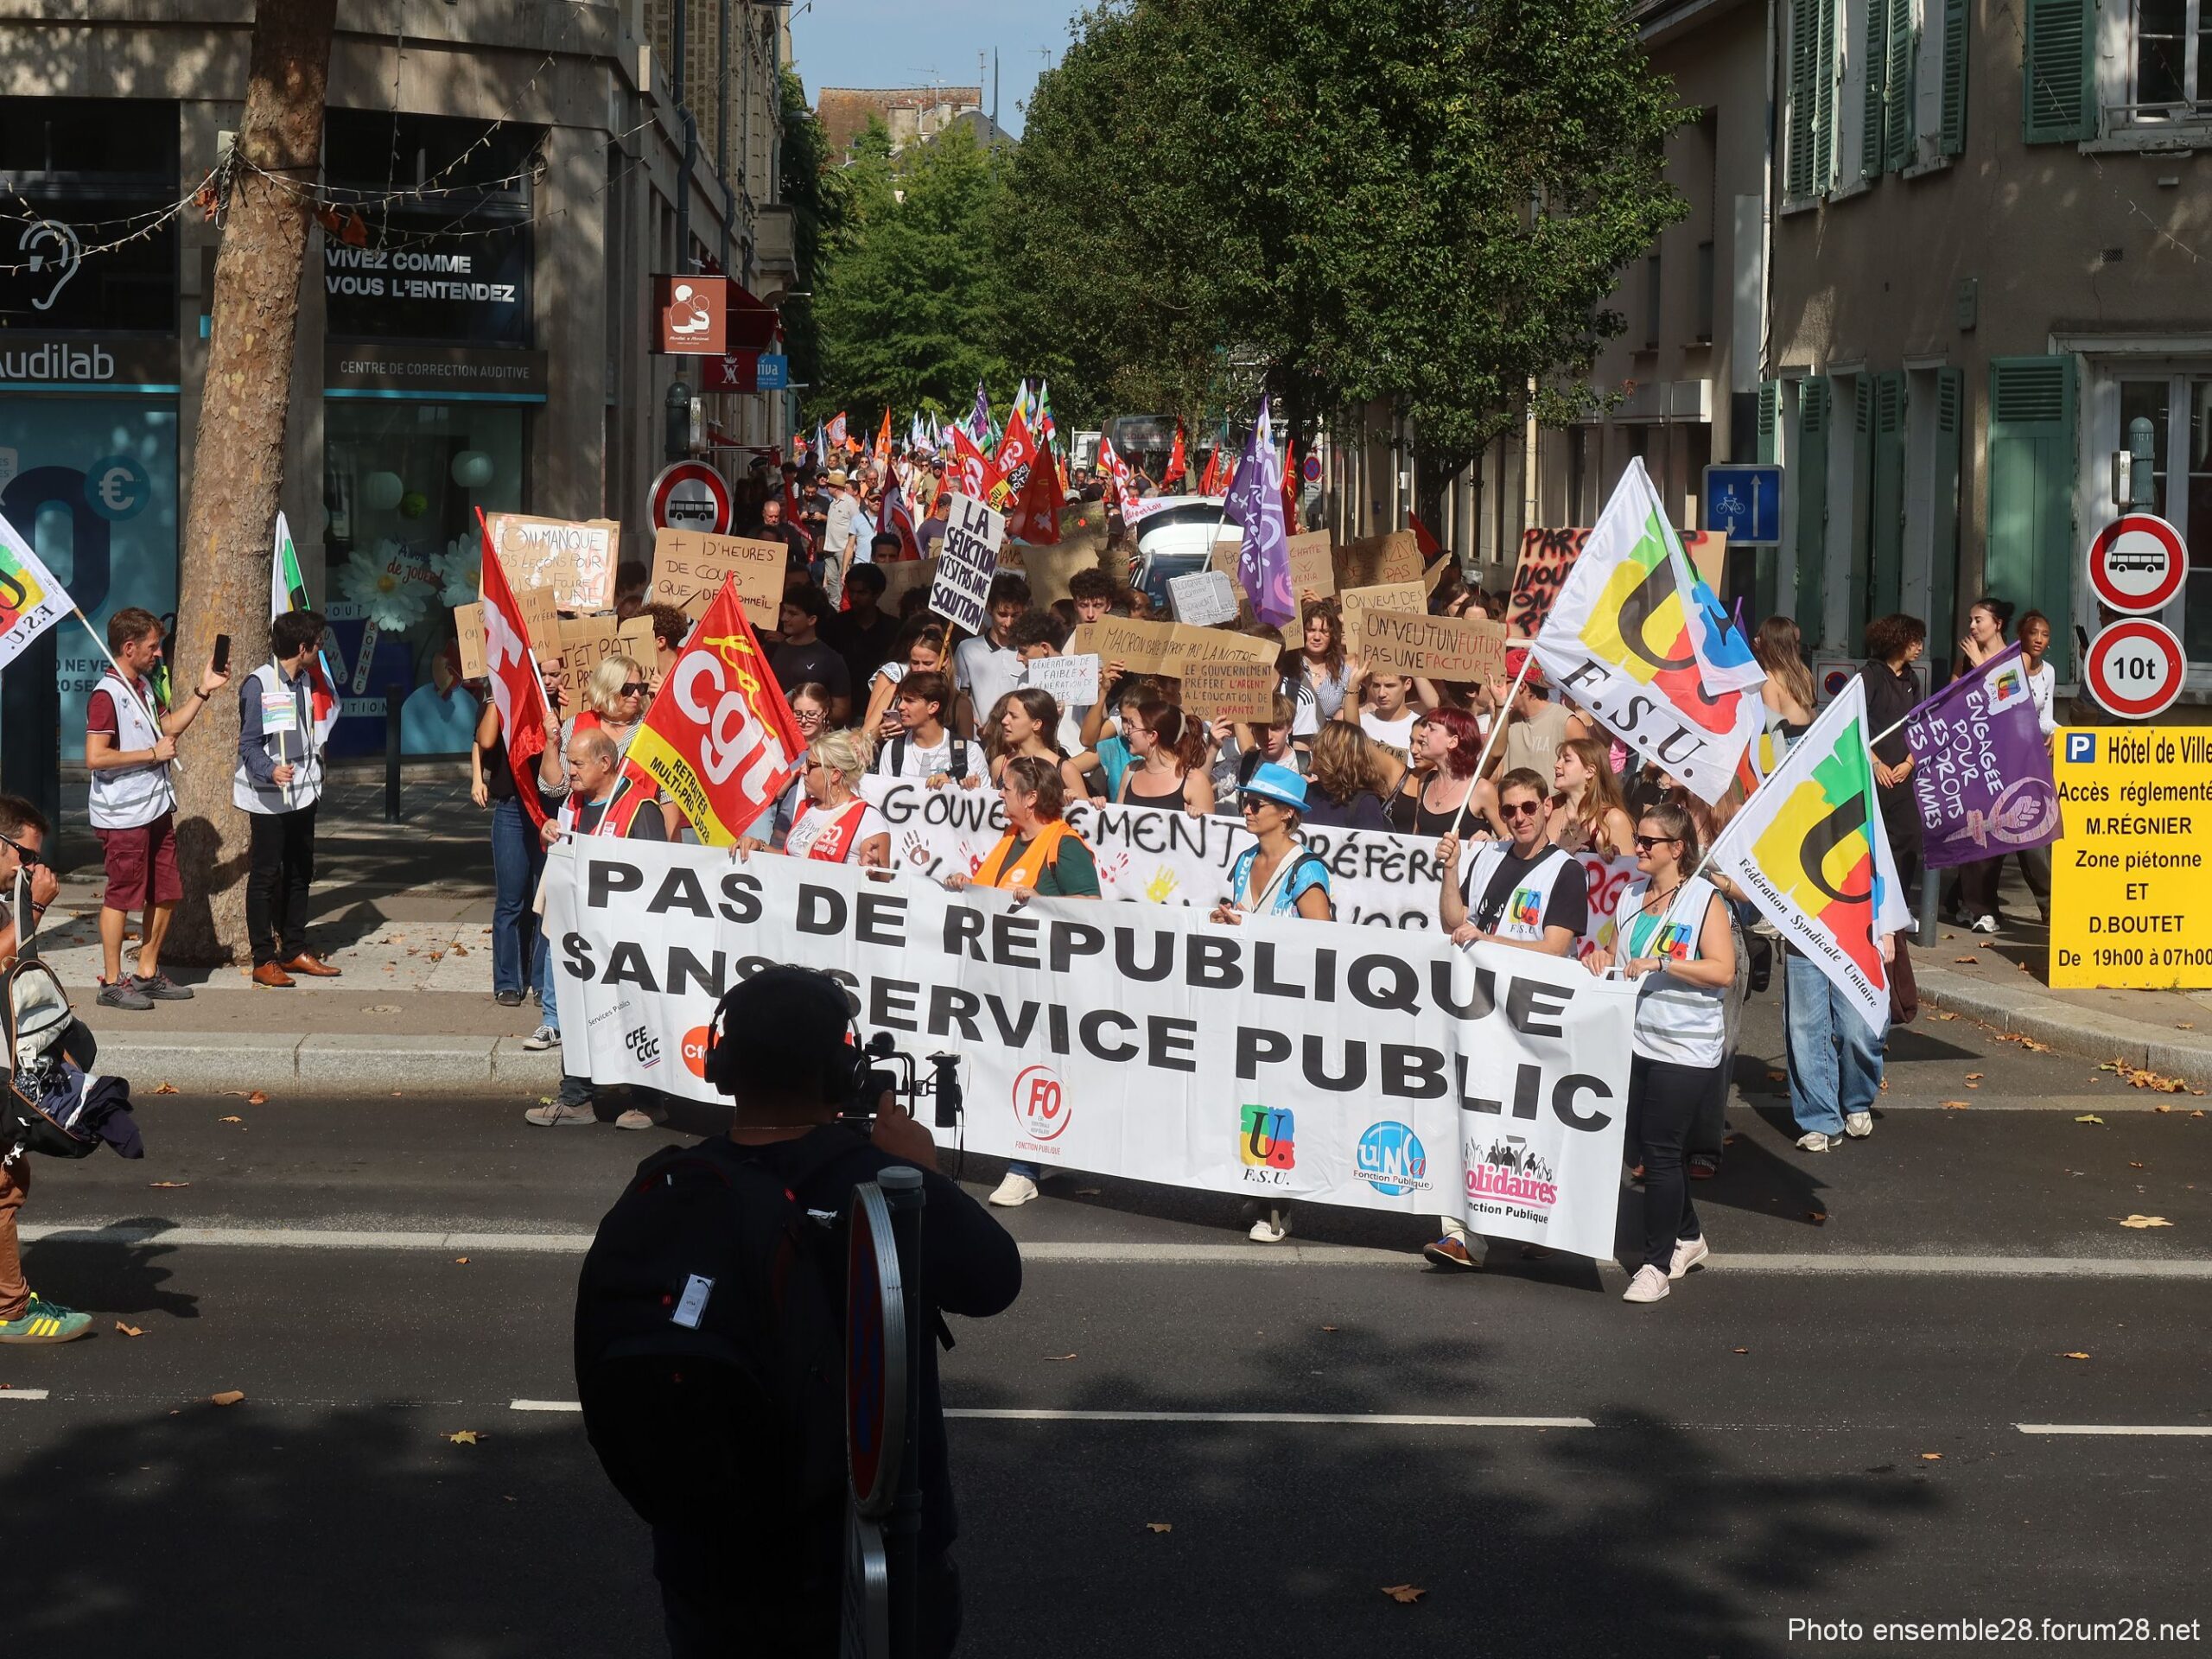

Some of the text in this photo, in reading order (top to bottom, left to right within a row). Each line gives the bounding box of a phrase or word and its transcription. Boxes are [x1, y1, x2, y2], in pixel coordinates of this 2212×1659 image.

[326, 248, 471, 273] VIVEZ COMME
[326, 276, 515, 302] VOUS L'ENTENDEZ
[340, 360, 530, 378] CENTRE DE CORRECTION AUDITIVE
[962, 500, 989, 540] LA
[541, 530, 603, 551] MANQUE
[702, 539, 776, 562] D'HEURES
[944, 527, 998, 579] SÉLECTION
[666, 560, 690, 575] DE
[658, 580, 691, 597] QUE
[737, 594, 772, 610] OMMEIL
[971, 574, 990, 601] UNE
[931, 582, 984, 629] SOLUTION
[1345, 594, 1366, 610] ON
[1102, 628, 1145, 655] MACRON
[1367, 613, 1389, 637] ON
[1437, 627, 1459, 654] UN
[1458, 632, 1503, 664] FUTUR
[1185, 664, 1272, 677] LE GOUVERNEMENT
[1363, 644, 1493, 677] PAS UNE FACTURE
[2113, 657, 2157, 680] 10t
[1230, 678, 1266, 690] L'ARGENT
[1258, 693, 1268, 702] DE
[1192, 705, 1210, 716] VOS
[1216, 706, 1255, 715] ENFANTS
[1557, 658, 1707, 779] F.S.U.
[1951, 718, 1980, 787] POUR
[1966, 690, 2005, 796] ENGAGÉE
[2071, 735, 2212, 764] P Hôtel de Ville
[1924, 702, 1966, 820] LES DROITS
[671, 759, 709, 815] RETRAITÉS
[1915, 754, 1943, 830] FEMMES
[2058, 781, 2212, 807] Accès réglementé
[694, 815, 710, 844] UD28
[2086, 813, 2193, 835] M.RÉGNIER
[2075, 850, 2202, 873] Zone piétonne
[2126, 883, 2150, 900] ET
[1738, 857, 1878, 1009] Fédération Syndicale Unitaire
[2089, 916, 2185, 934] D.BOUTET
[588, 859, 763, 925] PAS
[796, 883, 908, 948] DE
[943, 904, 1575, 1039] RÉPUBLIQUE
[2059, 949, 2212, 967] De 19h00 à 07h00
[588, 1008, 613, 1027] Services
[626, 1026, 647, 1050] CFE
[636, 1038, 660, 1062] CGC
[1236, 1026, 1613, 1132] PUBLIC
[1027, 1078, 1062, 1119] FO
[1015, 1141, 1061, 1155] FONCTION PUBLIQUE
[1243, 1167, 1290, 1185] F.S.U.
[1353, 1169, 1431, 1190] Fonction Publique
[1465, 1164, 1558, 1205] olidaires
[1469, 1201, 1549, 1224] nction Publique
